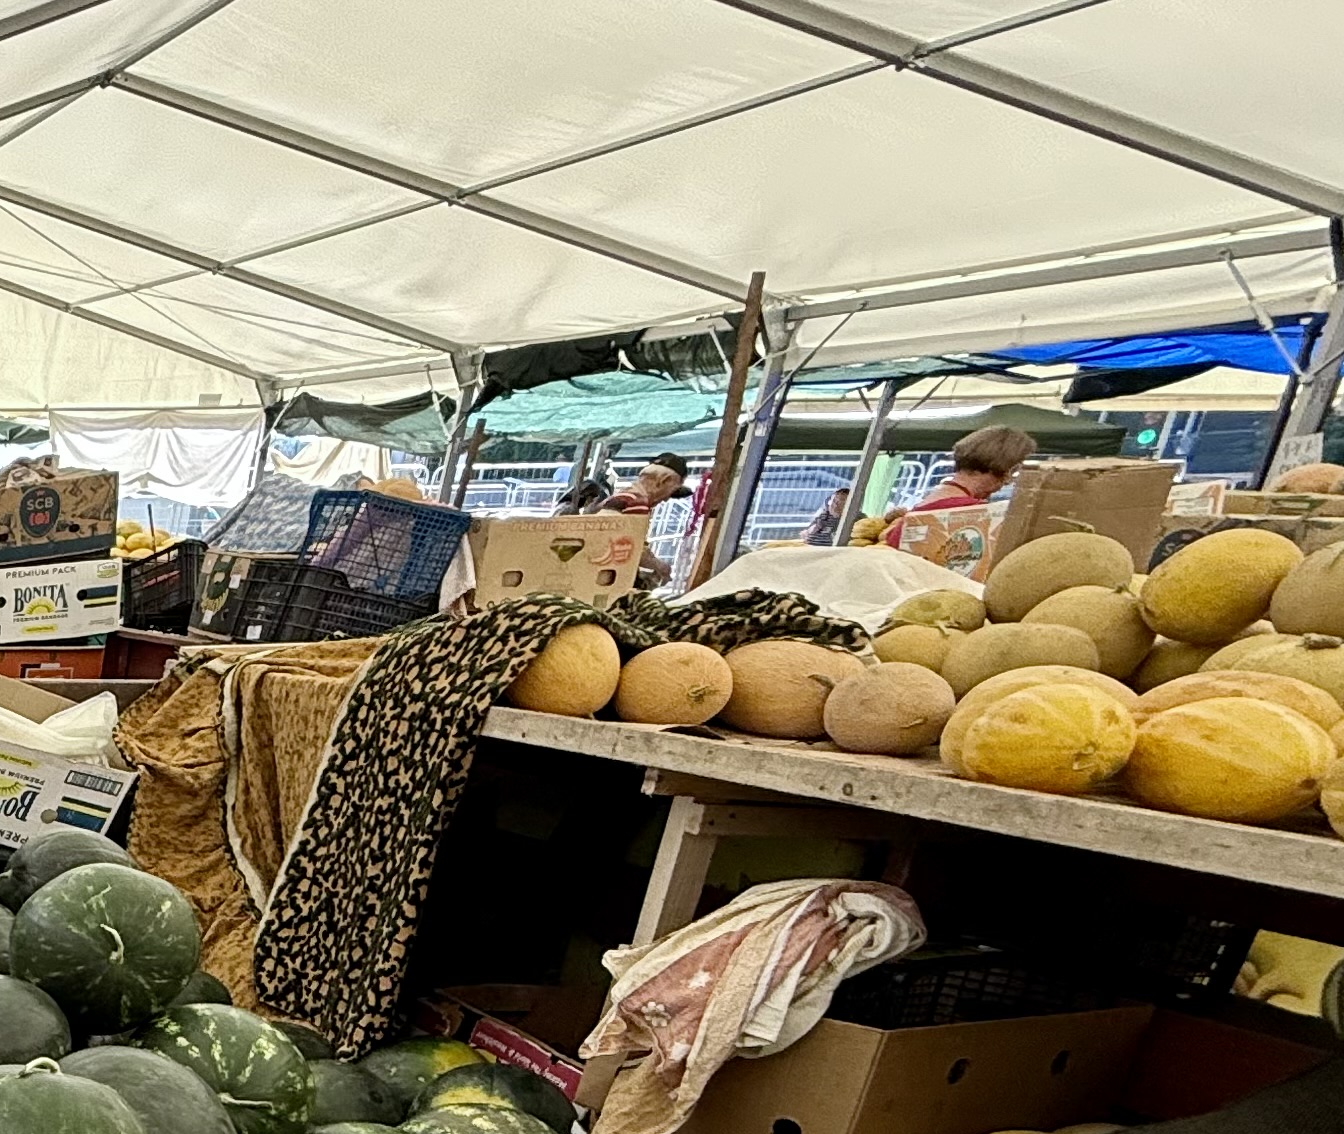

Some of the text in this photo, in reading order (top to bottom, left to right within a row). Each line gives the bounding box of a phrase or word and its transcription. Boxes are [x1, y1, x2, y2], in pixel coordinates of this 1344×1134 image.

[26, 497, 54, 511] SCB
[6, 565, 77, 579] PREMIUM PACK
[13, 584, 68, 614] BONITA
